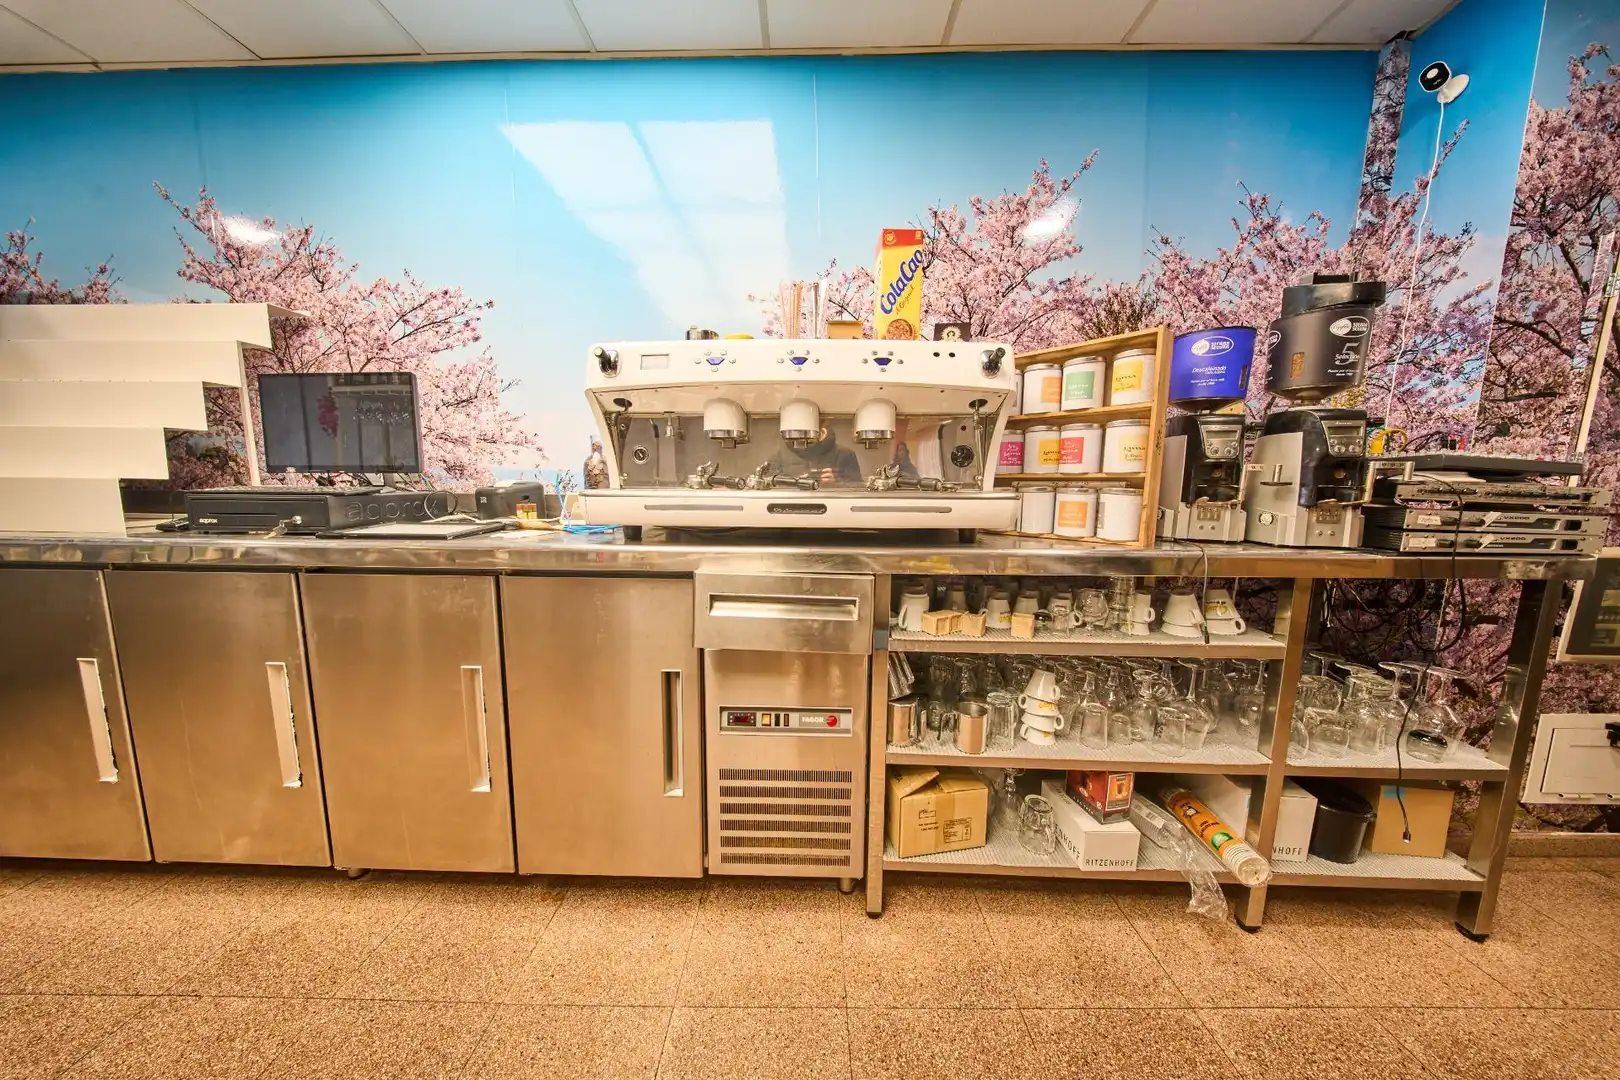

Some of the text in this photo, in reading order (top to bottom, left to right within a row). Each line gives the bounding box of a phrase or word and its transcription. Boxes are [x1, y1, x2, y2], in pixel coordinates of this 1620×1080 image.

[880, 249, 922, 315] ColaCao
[1272, 847, 1302, 855] NHOFF
[1085, 859, 1135, 867] RITZENHOFF
